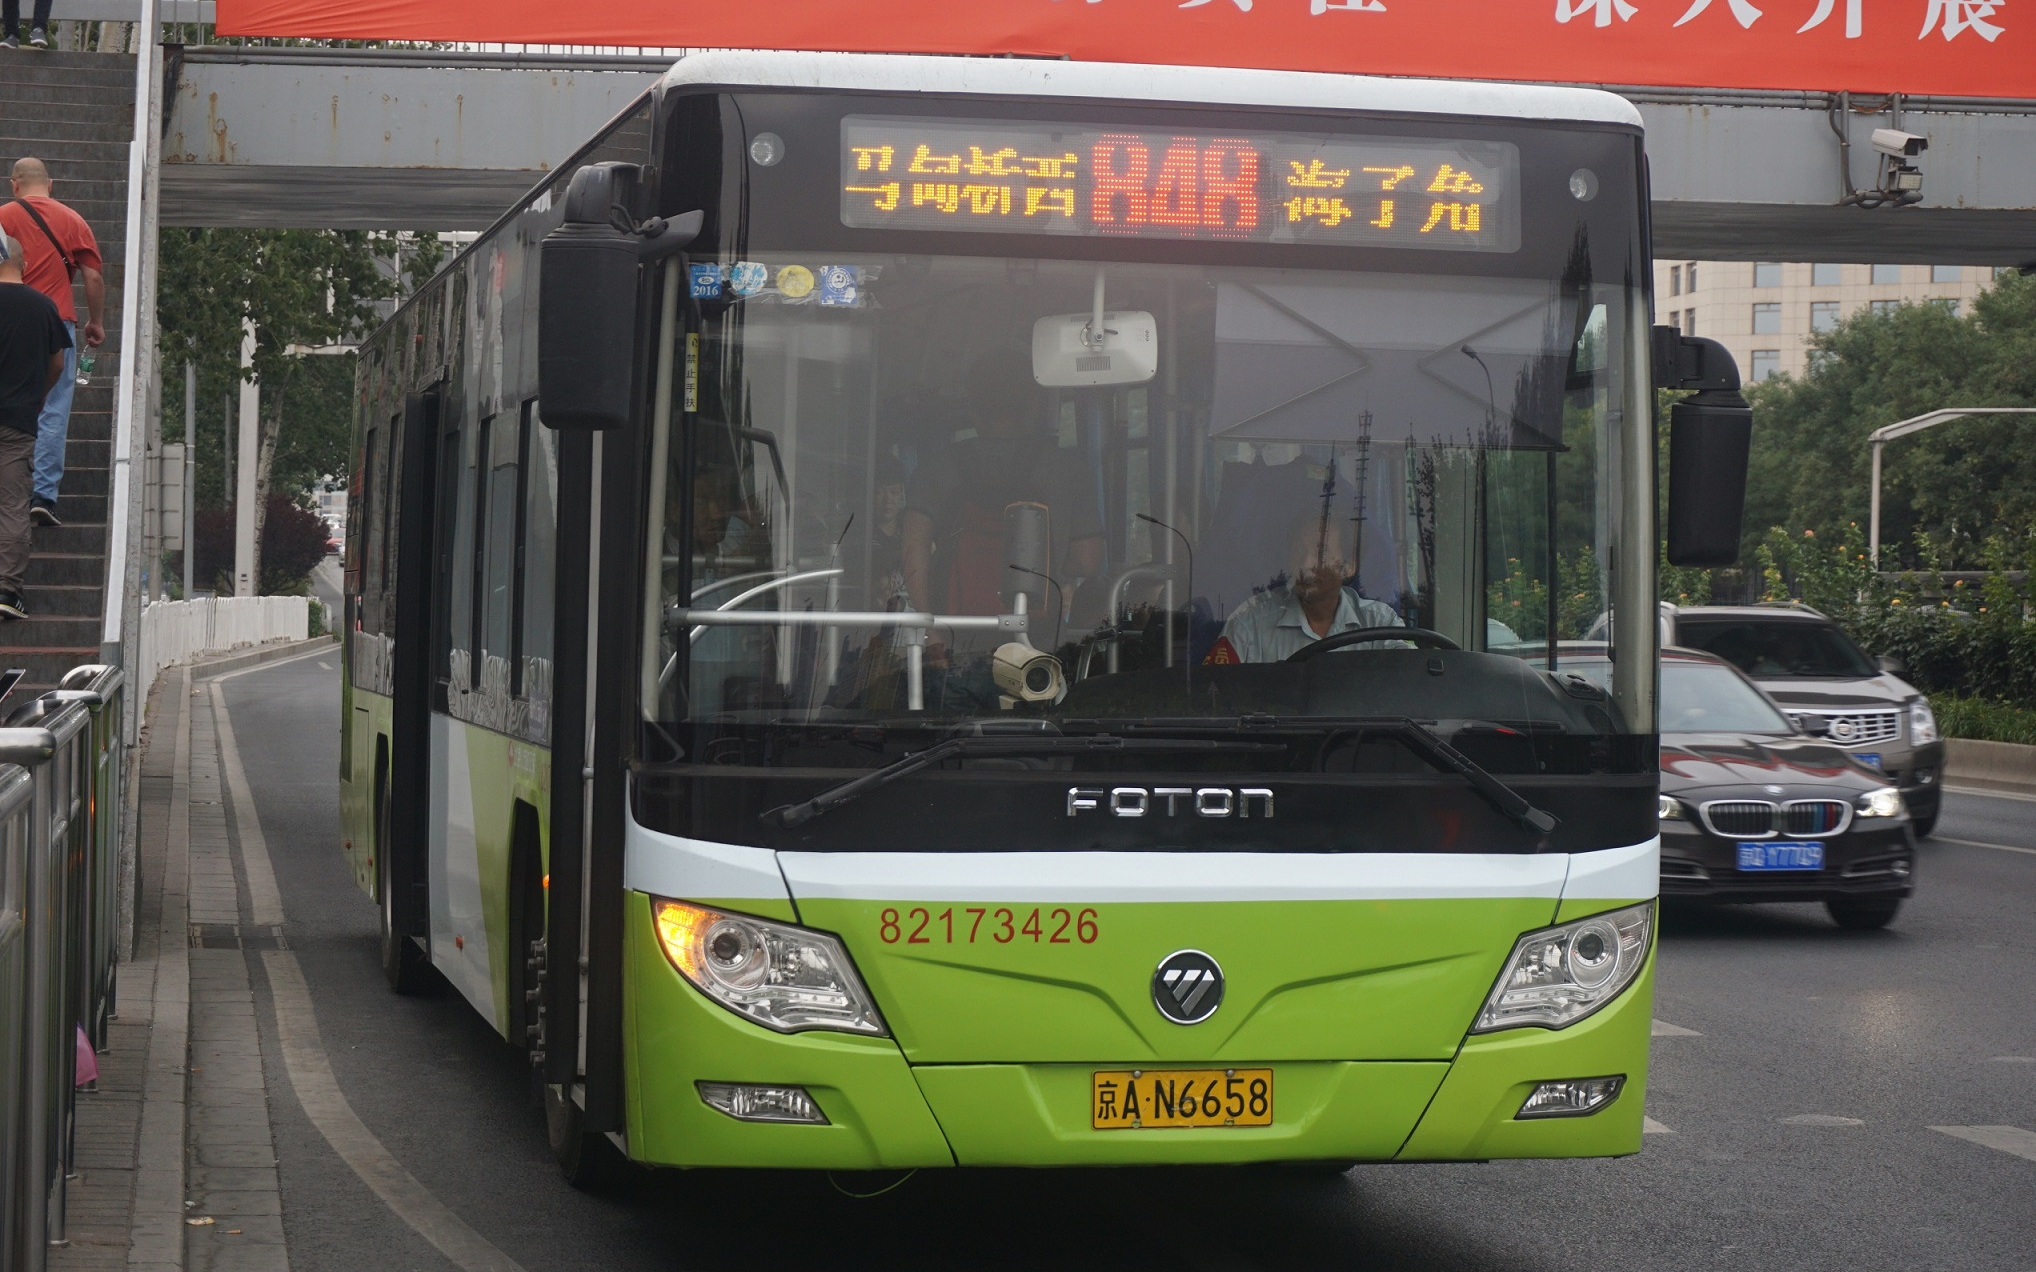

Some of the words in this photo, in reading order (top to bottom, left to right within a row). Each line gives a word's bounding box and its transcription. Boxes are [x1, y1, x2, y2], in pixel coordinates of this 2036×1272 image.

[1093, 134, 1257, 237] 848
[693, 285, 719, 296] 2016
[685, 353, 697, 408] 禁止手扶
[1067, 787, 1274, 818] FOTON
[880, 907, 1099, 945] 82173426
[1097, 1077, 1269, 1120] 京A·N6658
